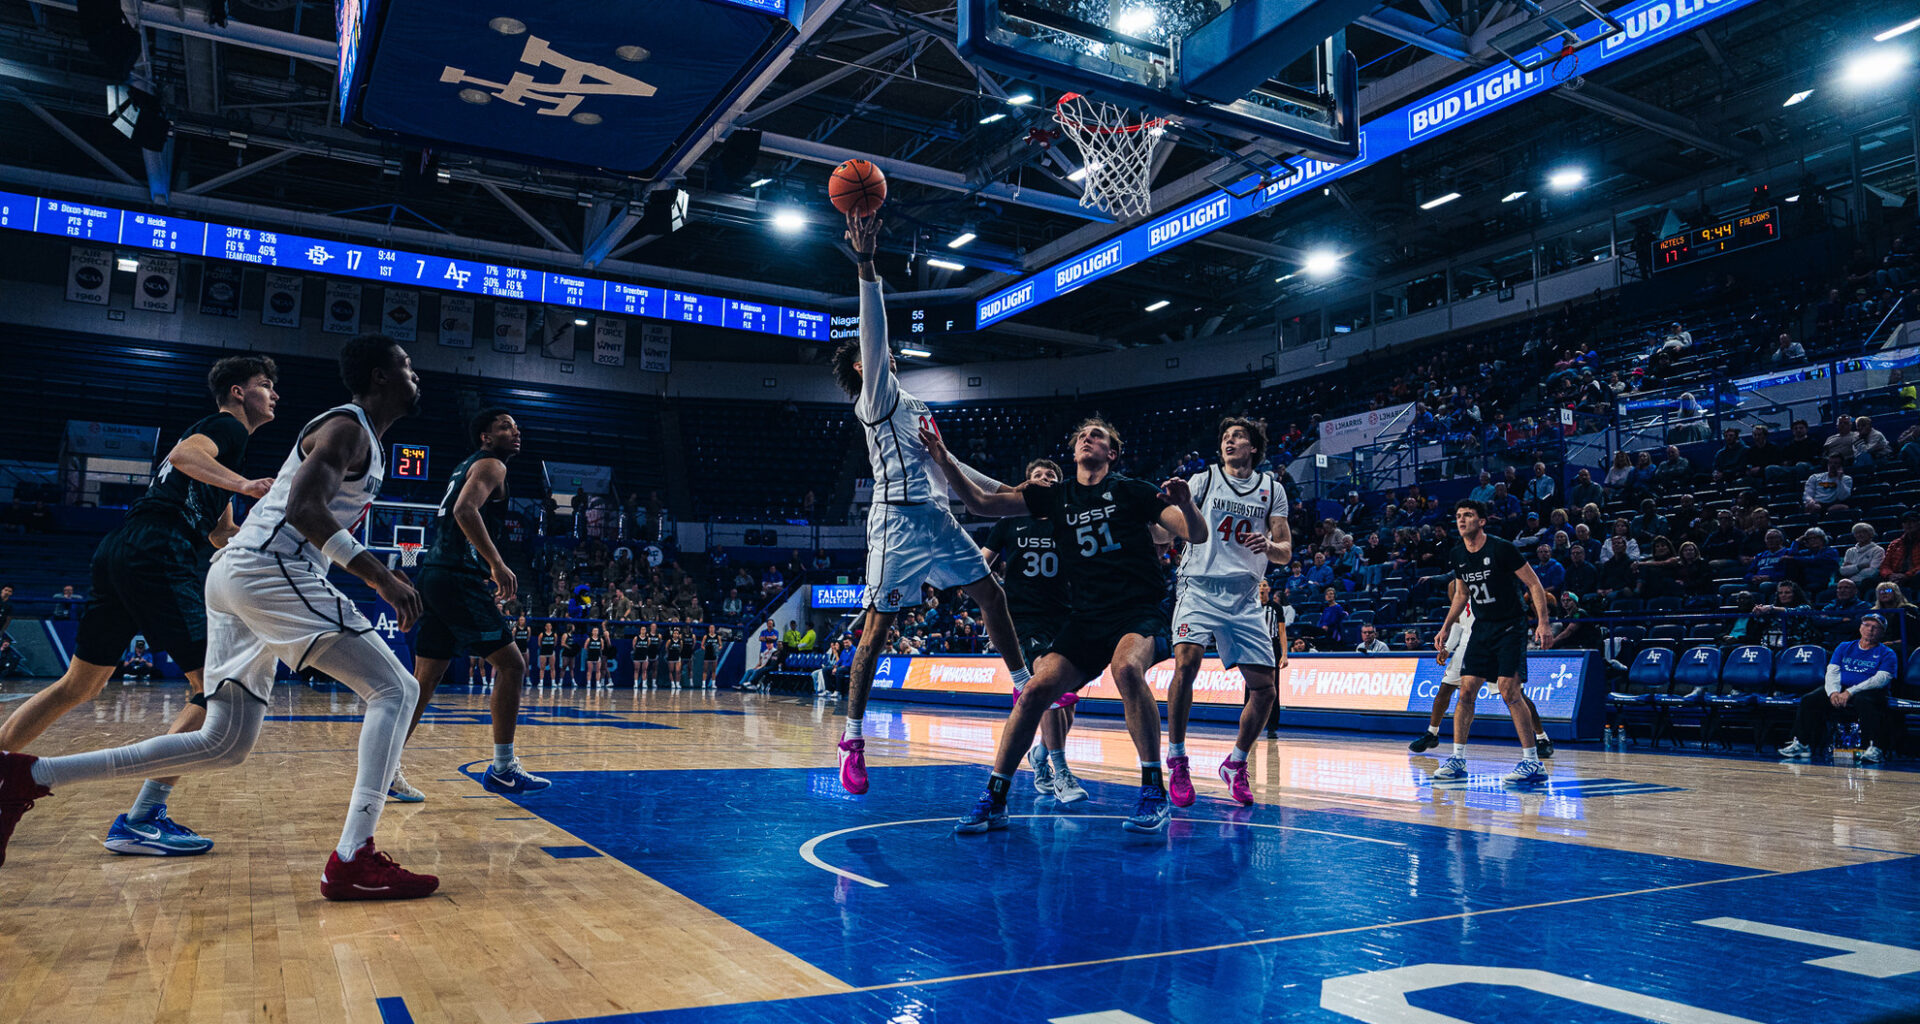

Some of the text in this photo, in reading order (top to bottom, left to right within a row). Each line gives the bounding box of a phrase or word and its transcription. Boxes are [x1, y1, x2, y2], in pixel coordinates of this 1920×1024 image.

[1606, 2, 1671, 50] BUD
[1413, 64, 1537, 134] BUD LIGHT
[1267, 166, 1304, 196] BUD
[3, 206, 9, 215] 0
[48, 202, 108, 218] 39 Dixon-Waters
[2, 217, 8, 226] 0
[68, 216, 93, 227] PTS 6
[147, 216, 166, 228] Heide
[1150, 198, 1226, 246] BUD LIGHT
[1740, 211, 1770, 227] FALCONS
[67, 226, 91, 237] FLS 1
[154, 229, 177, 240] PTS 0
[226, 227, 277, 244] 3PT % 33%
[1702, 224, 1731, 240] 9:44
[1765, 224, 1773, 235] 7
[152, 239, 176, 250] FLS 0
[226, 241, 276, 257] FG % 46%
[1661, 236, 1684, 250] AZTECS
[1721, 242, 1724, 250] 1
[72, 255, 107, 266] FORCE
[226, 251, 277, 266] TEAM FOULS 3
[346, 250, 362, 270] 17
[378, 250, 395, 262] 9:44
[1666, 250, 1677, 263] 17
[140, 264, 175, 274] FORCE
[380, 266, 392, 277] 1ST
[416, 260, 425, 279] 7
[486, 266, 527, 280] 17% 3PT %
[1057, 246, 1119, 288] BUD LIGHT
[444, 262, 471, 288] AF
[143, 280, 169, 290] NCAA
[483, 277, 522, 290] 30% FG %
[554, 276, 585, 288] 2 Patterson
[76, 292, 101, 302] 1960
[482, 286, 524, 298] 3 TEAM FOULS
[567, 288, 583, 296] PTS 0
[623, 286, 648, 298] Greenberg
[566, 297, 582, 306] FLS 1
[626, 295, 635, 303] PTS
[980, 286, 1032, 321] BUD LIGHT
[143, 301, 168, 310] 1962
[625, 304, 634, 312] FLS
[684, 303, 693, 311] PTS
[497, 311, 527, 320] FORCE
[831, 316, 860, 326] Niagar
[912, 310, 924, 320] 55
[605, 320, 617, 328] AIR
[912, 323, 924, 332] 56
[947, 321, 953, 330] F
[597, 328, 623, 338] FORCE
[830, 328, 860, 339] Quinni
[597, 342, 622, 352] WNIT
[599, 355, 619, 364] 2022
[1380, 410, 1409, 420] L3HARS
[402, 448, 425, 459] 9:44
[399, 458, 421, 476] 21
[1213, 498, 1264, 518] SAN DIEGO STATE
[1066, 504, 1117, 526] USSF
[1076, 522, 1122, 558] 51
[1022, 551, 1059, 578] 30
[1461, 569, 1492, 583] USSF
[818, 590, 855, 599] FALCON
[1469, 582, 1496, 604] 21
[1647, 650, 1661, 664] AF
[1694, 650, 1709, 664] AF
[1742, 649, 1758, 663] AF
[1795, 648, 1812, 662] AF
[1156, 669, 1244, 690] WBURGER
